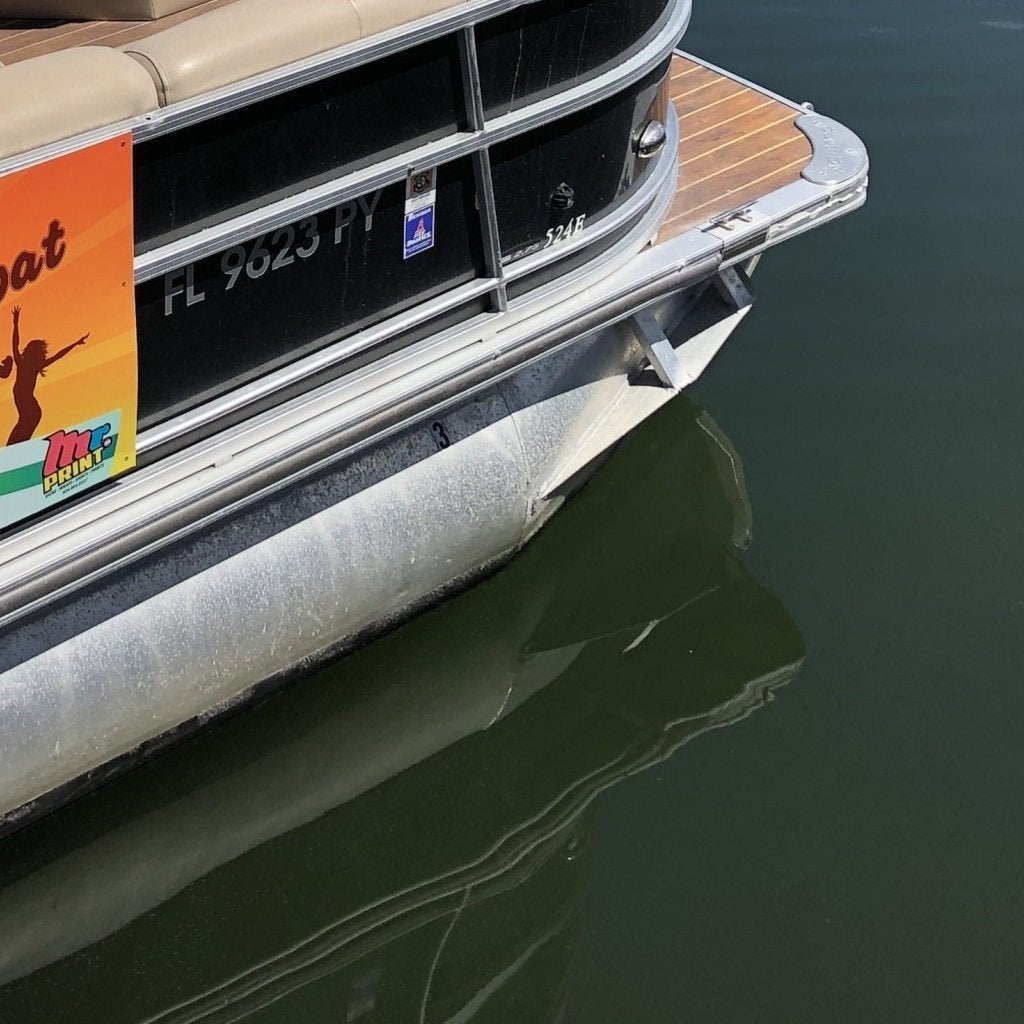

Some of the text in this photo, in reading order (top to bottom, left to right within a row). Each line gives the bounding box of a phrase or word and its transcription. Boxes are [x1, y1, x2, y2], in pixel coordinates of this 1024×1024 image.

[164, 189, 384, 316] FL 9623 PY
[432, 421, 451, 449] 3
[43, 447, 104, 494] PRINT
